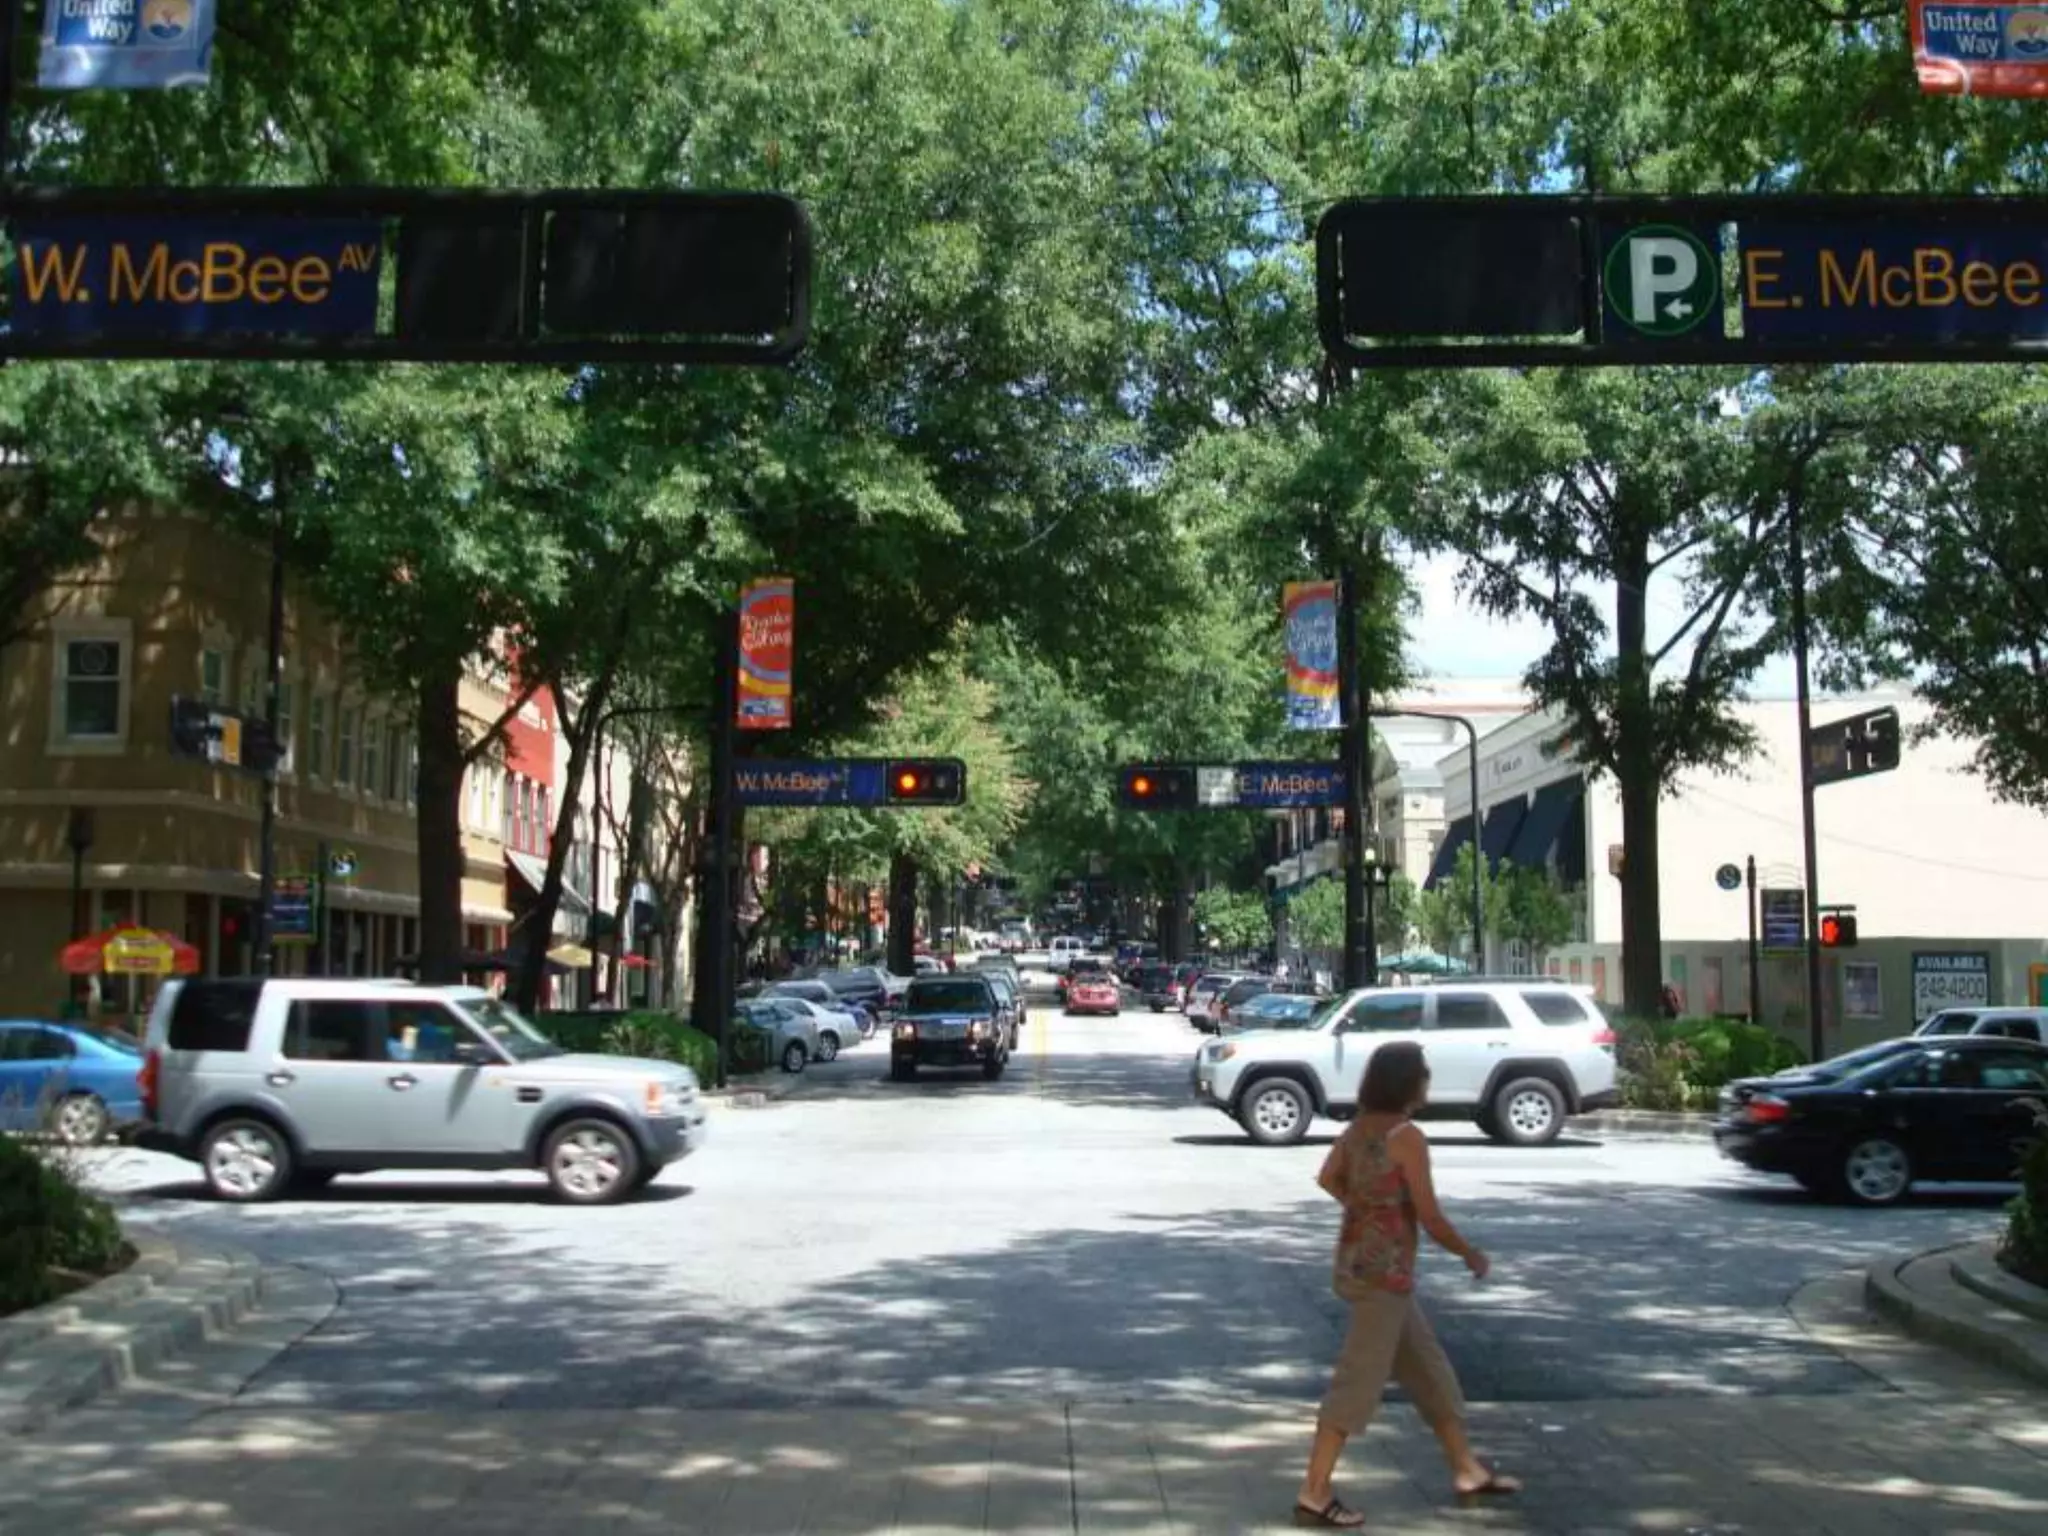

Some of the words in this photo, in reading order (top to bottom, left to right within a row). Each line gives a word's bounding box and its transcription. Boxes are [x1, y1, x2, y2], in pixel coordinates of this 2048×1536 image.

[63, 0, 134, 17] United
[88, 17, 133, 44] Way
[1926, 11, 1997, 31] United
[1957, 34, 1998, 58] Way
[21, 242, 90, 303] W.
[108, 242, 332, 304] McBee
[338, 244, 376, 273] AV
[1629, 236, 1698, 324] P
[1746, 249, 1803, 308] E.
[1818, 247, 2041, 308] McBee
[1261, 773, 1330, 795] McBee
[1917, 956, 1985, 969] AVAILABLE
[1919, 976, 1985, 999] 242-4200
